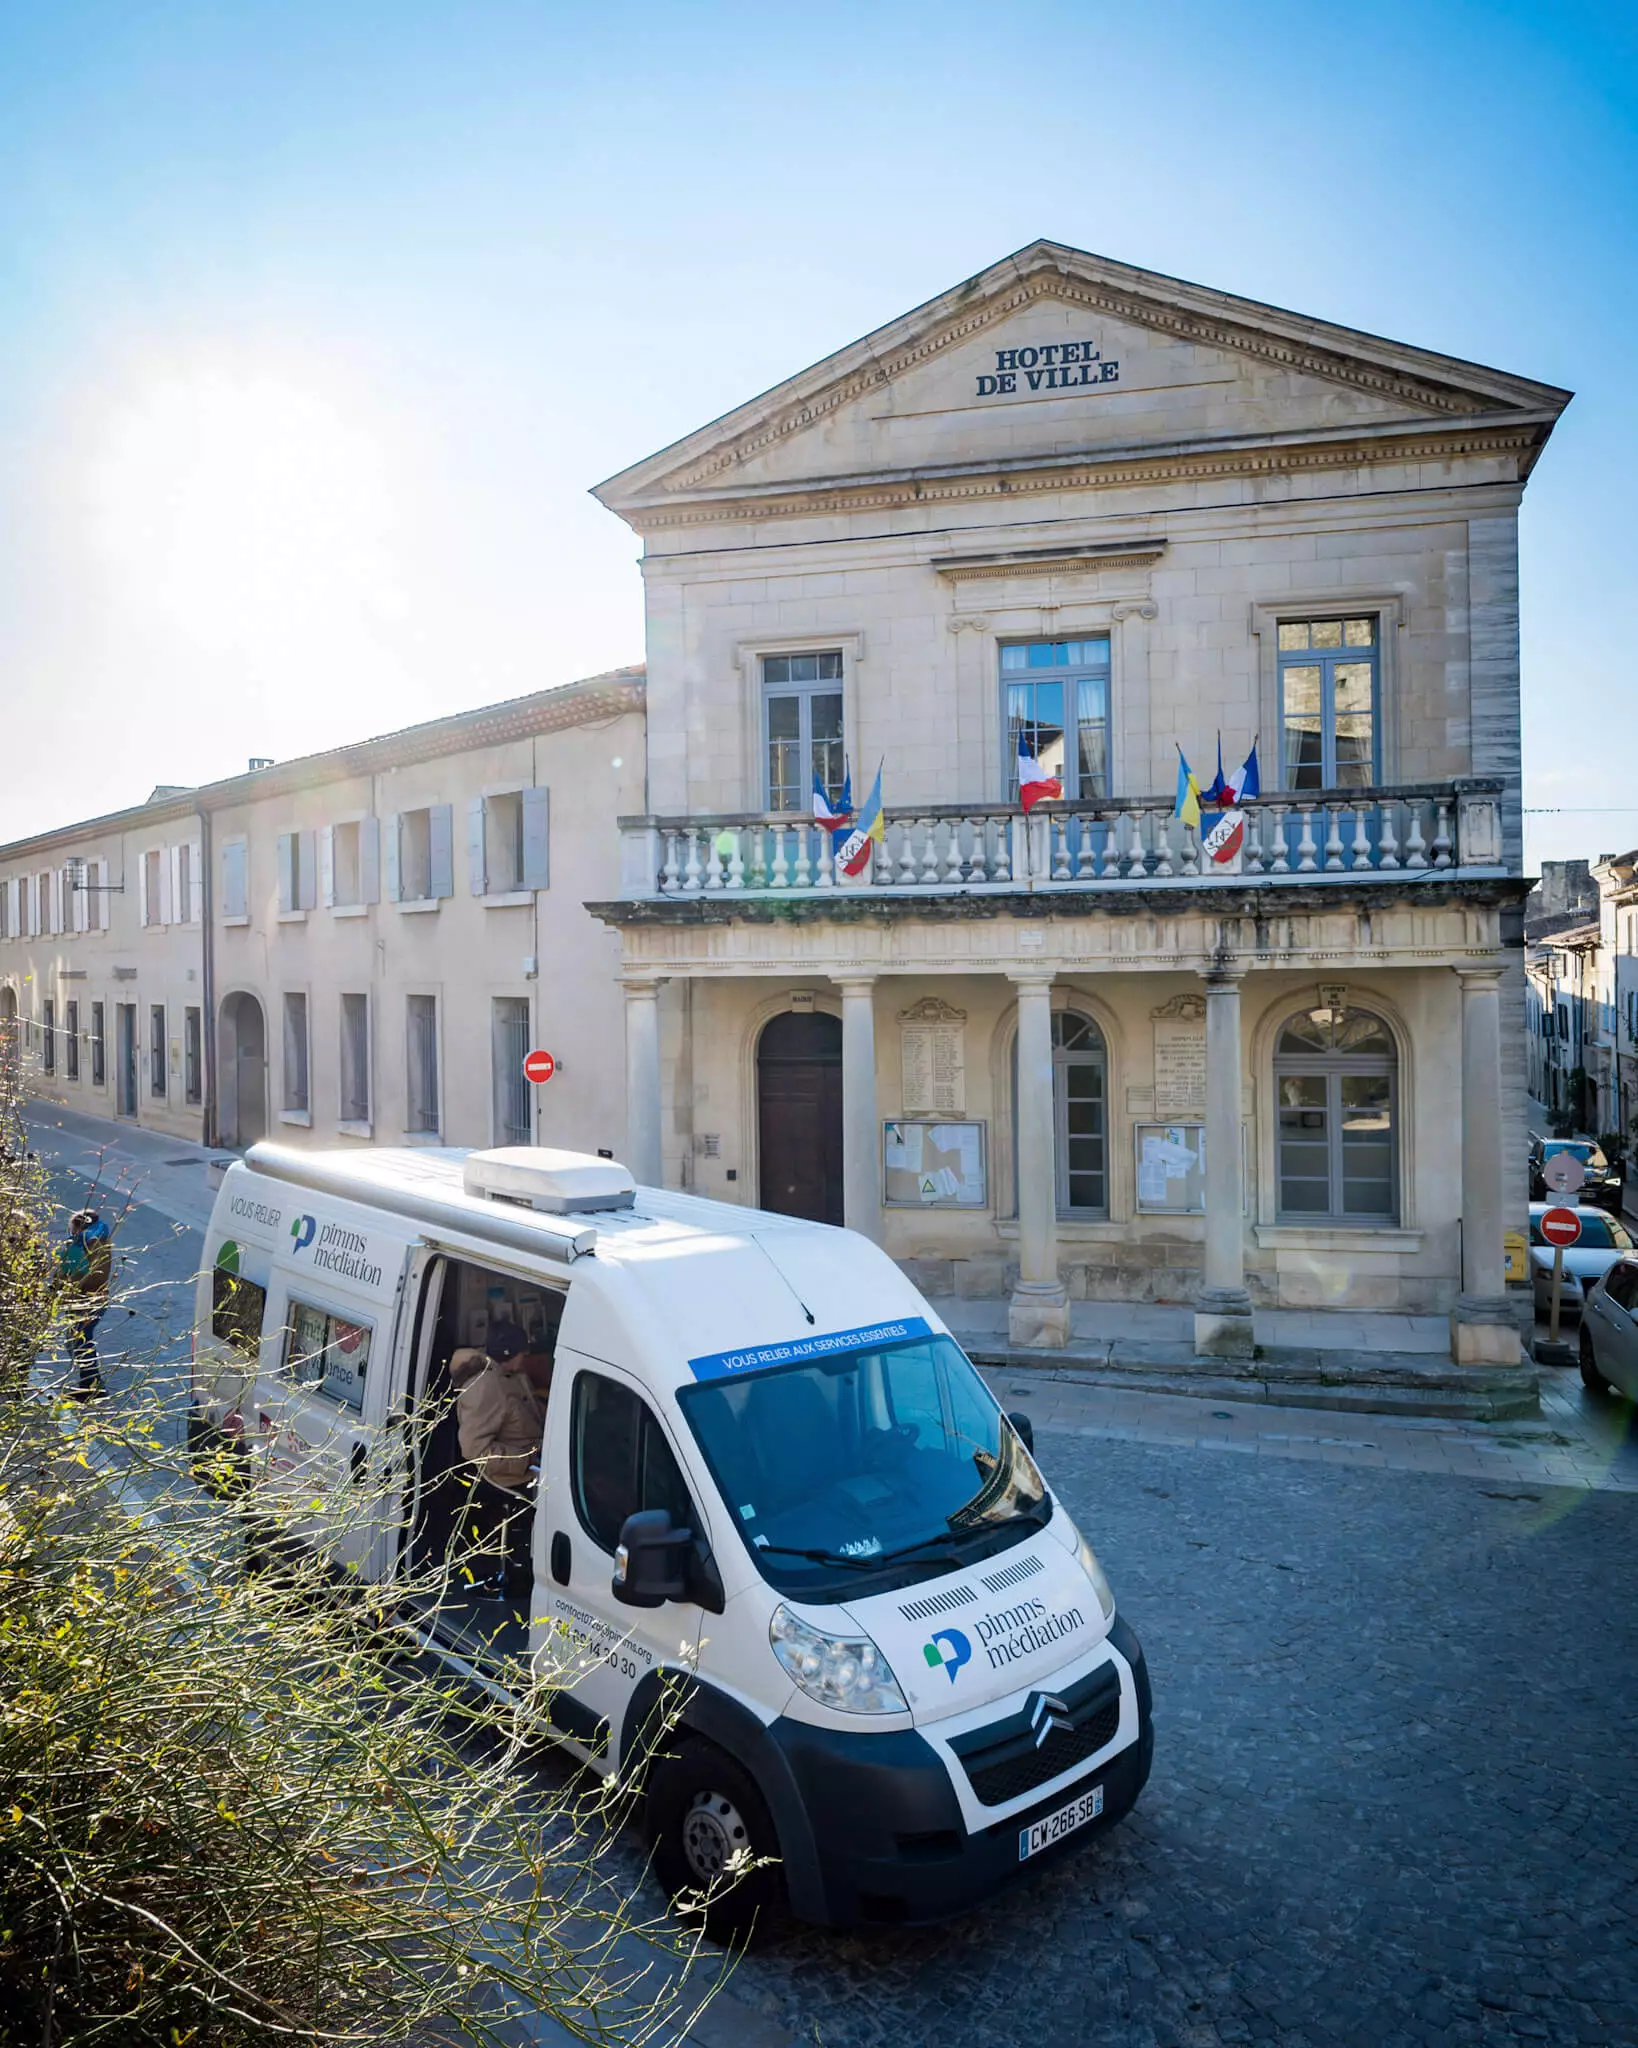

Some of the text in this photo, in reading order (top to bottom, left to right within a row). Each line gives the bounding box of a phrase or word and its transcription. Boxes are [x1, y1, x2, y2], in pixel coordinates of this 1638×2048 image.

[995, 341, 1100, 371] HOTEL
[975, 361, 1119, 396] DE VILLE
[230, 1195, 281, 1227] VOUS RELIER
[318, 1223, 367, 1255] pimms
[313, 1247, 382, 1287] médiation
[722, 1324, 907, 1369] VOUS RELIER AUX SERVICES ESSENTIELS
[974, 1597, 1046, 1647] pimms
[986, 1608, 1085, 1669] médiation
[620, 1658, 636, 1679] 30
[1031, 1795, 1094, 1850] CW-266-SB
